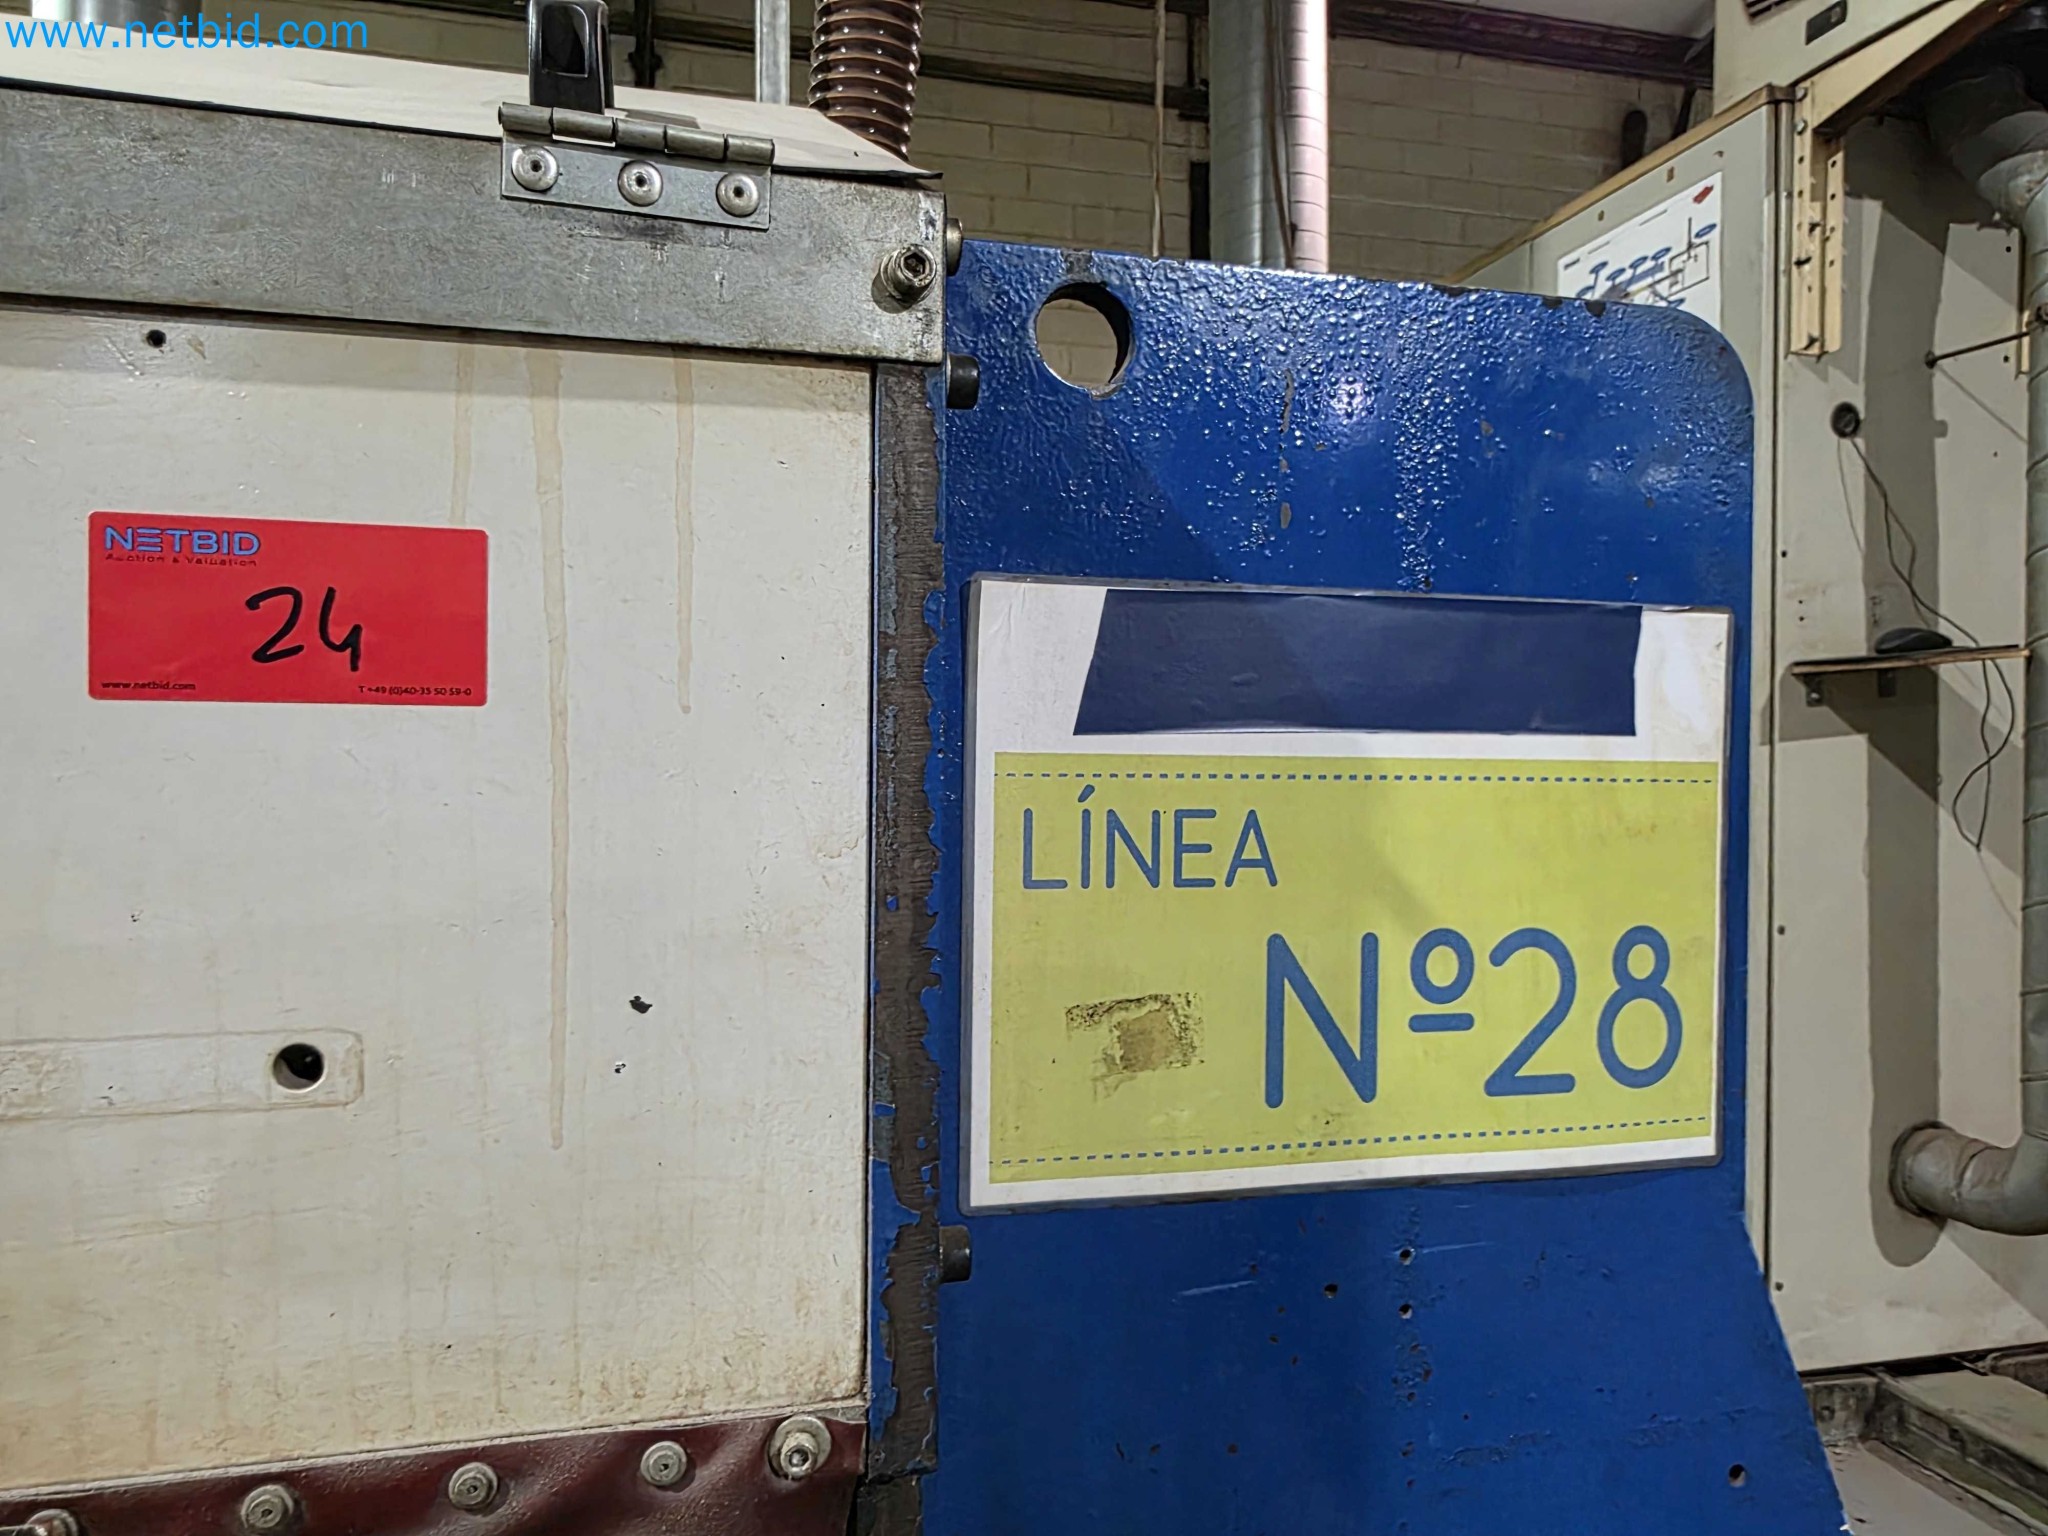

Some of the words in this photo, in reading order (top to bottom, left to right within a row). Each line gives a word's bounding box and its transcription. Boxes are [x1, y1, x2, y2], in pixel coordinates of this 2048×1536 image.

[104, 525, 261, 556] NETBID
[186, 556, 257, 567] Valuation
[245, 585, 364, 672] 24
[101, 681, 196, 690] www.netbid.com
[358, 685, 366, 693] T
[1022, 785, 1278, 889] LÍNEA
[1263, 925, 1683, 1109] Nº28
